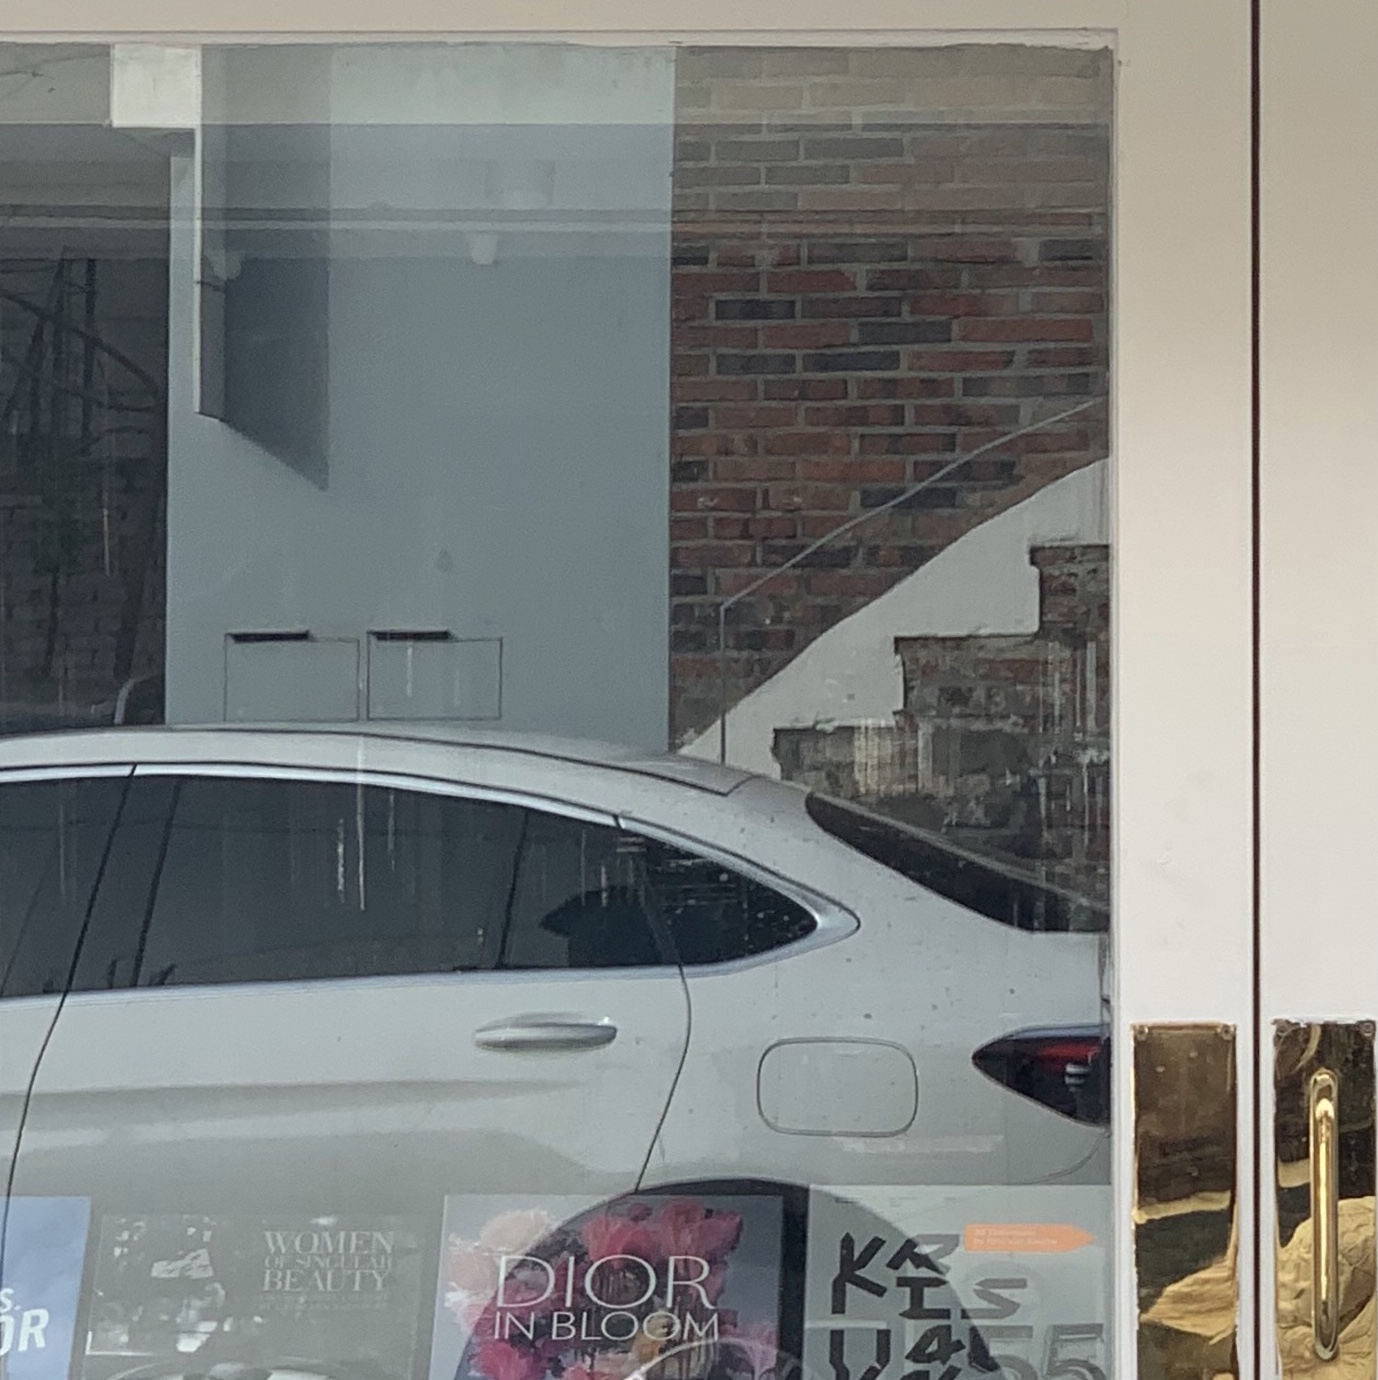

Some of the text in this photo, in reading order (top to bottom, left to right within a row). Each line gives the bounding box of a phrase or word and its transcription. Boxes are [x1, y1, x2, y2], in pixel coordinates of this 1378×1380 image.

[263, 1230, 395, 1254] WOMEN
[262, 1268, 391, 1292] BEAUTY
[497, 1254, 716, 1309] DIOR
[494, 1311, 719, 1341] IN BLOOM
